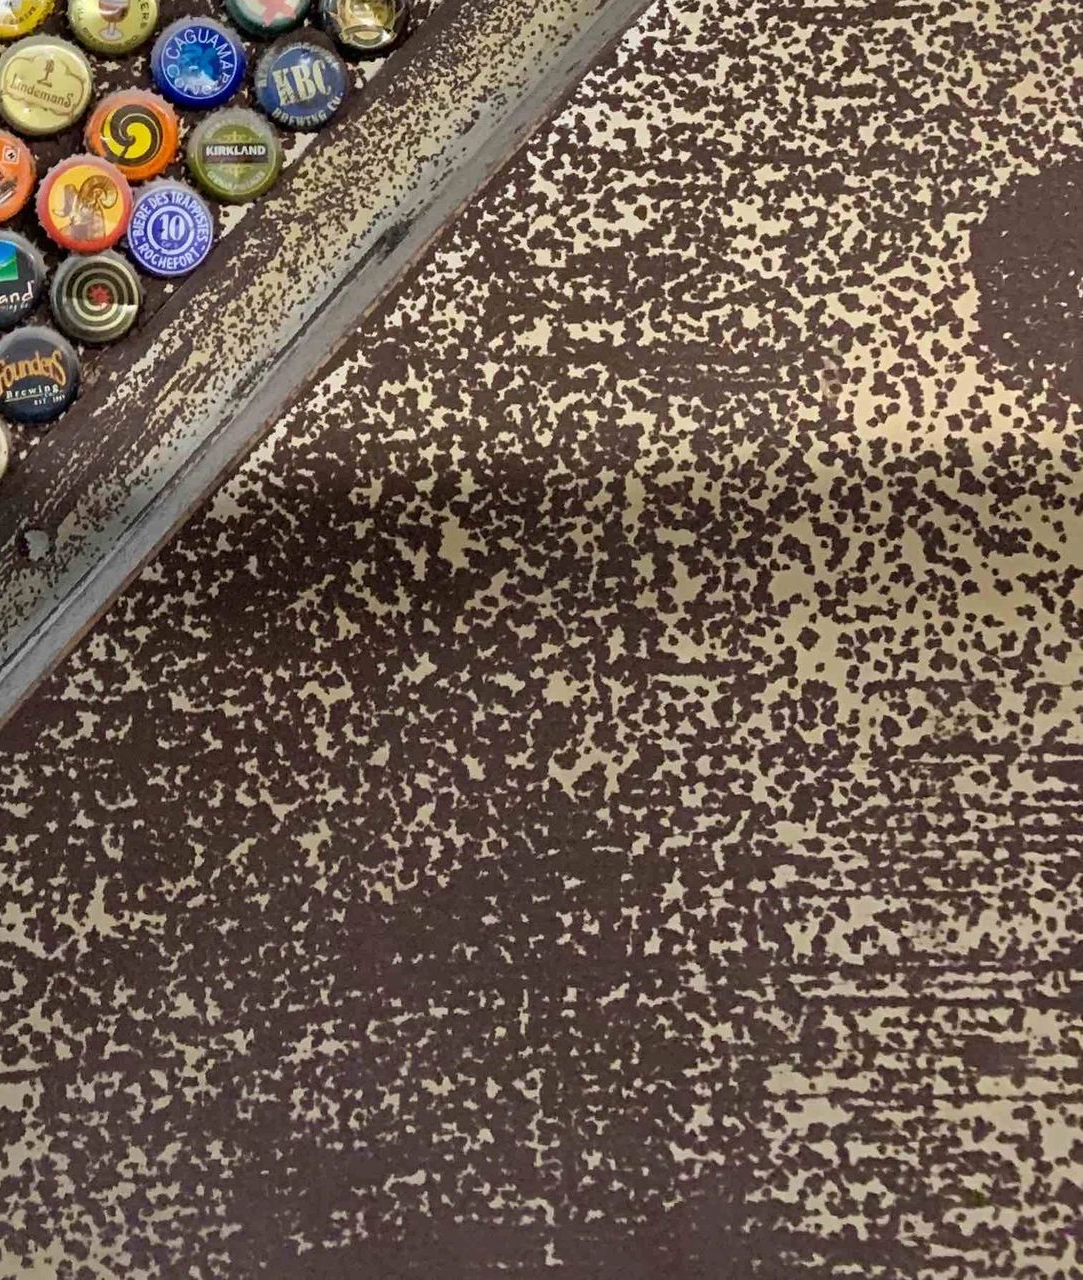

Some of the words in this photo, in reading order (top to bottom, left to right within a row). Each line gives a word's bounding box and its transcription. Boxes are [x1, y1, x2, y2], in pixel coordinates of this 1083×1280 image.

[271, 107, 327, 128] BREWING
[205, 144, 266, 157] KIRKLAND
[133, 204, 151, 237] BIERE
[149, 191, 168, 209] DES
[171, 190, 209, 242] TRAPPISTES
[158, 214, 185, 241] 10
[138, 243, 200, 269] ROCHEFORT
[5, 383, 60, 399] Brewing
